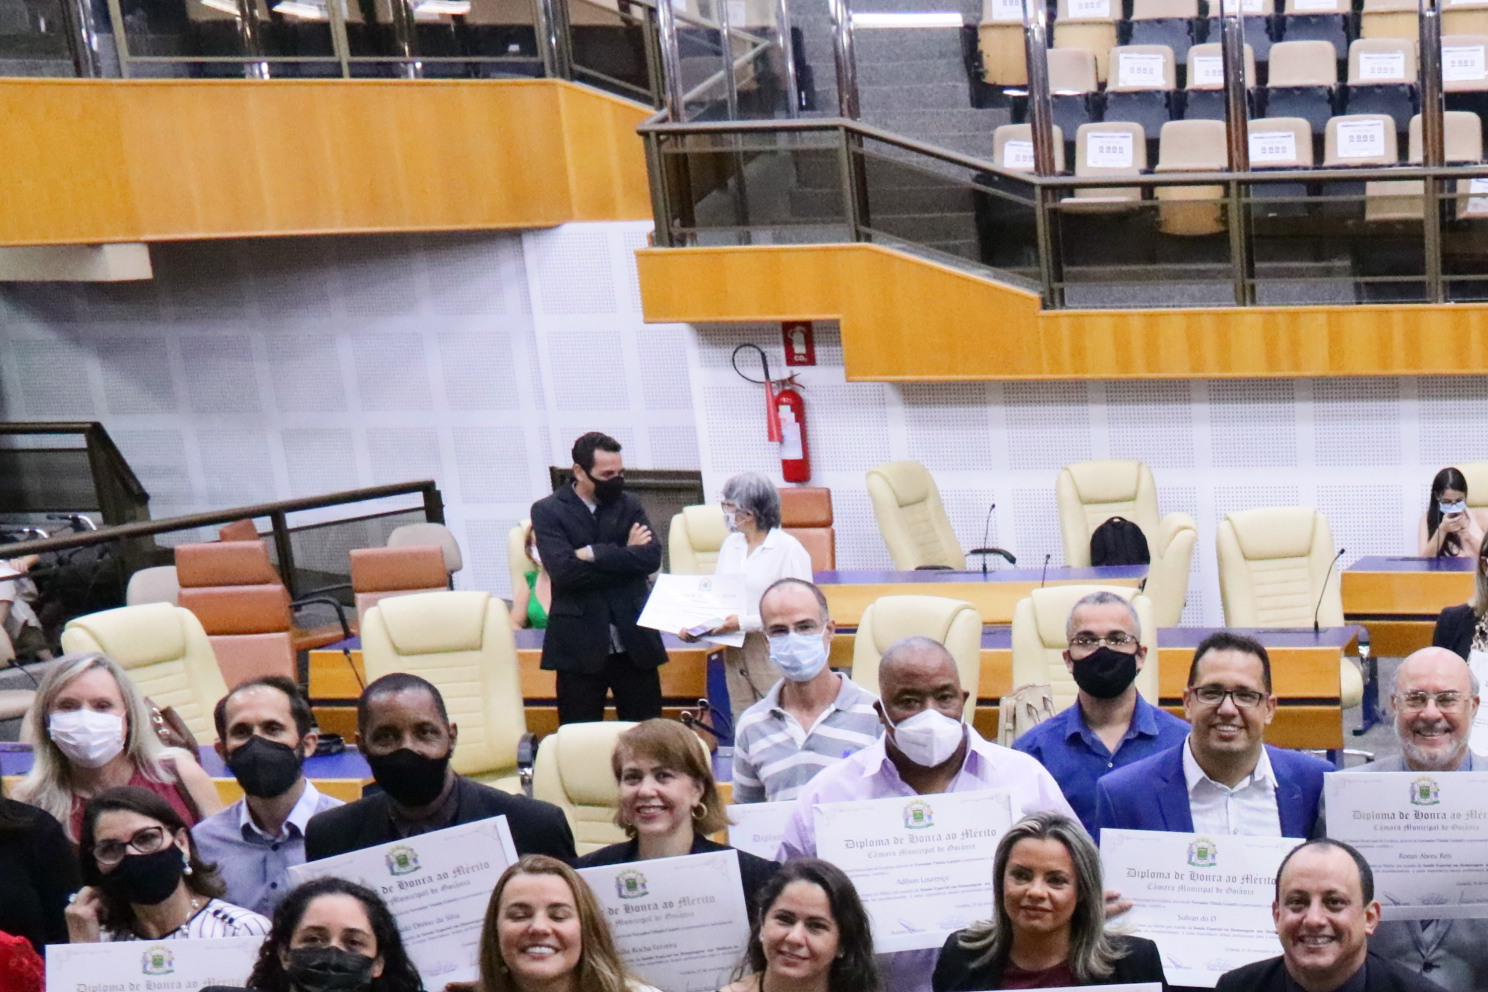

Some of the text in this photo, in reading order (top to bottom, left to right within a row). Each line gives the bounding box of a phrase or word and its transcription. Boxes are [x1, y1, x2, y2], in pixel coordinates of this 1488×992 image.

[1349, 810, 1395, 821] Diploma
[1398, 810, 1410, 820] de
[1413, 809, 1447, 820] Honra
[843, 827, 996, 849] Diploma de Honra ao Mérito
[380, 861, 490, 894] de Honra ao Mérito
[1125, 867, 1276, 884] Diploma de Honra ao Mérito
[128, 981, 141, 991] de
[144, 979, 182, 990] Honra
[185, 980, 198, 989] ao
